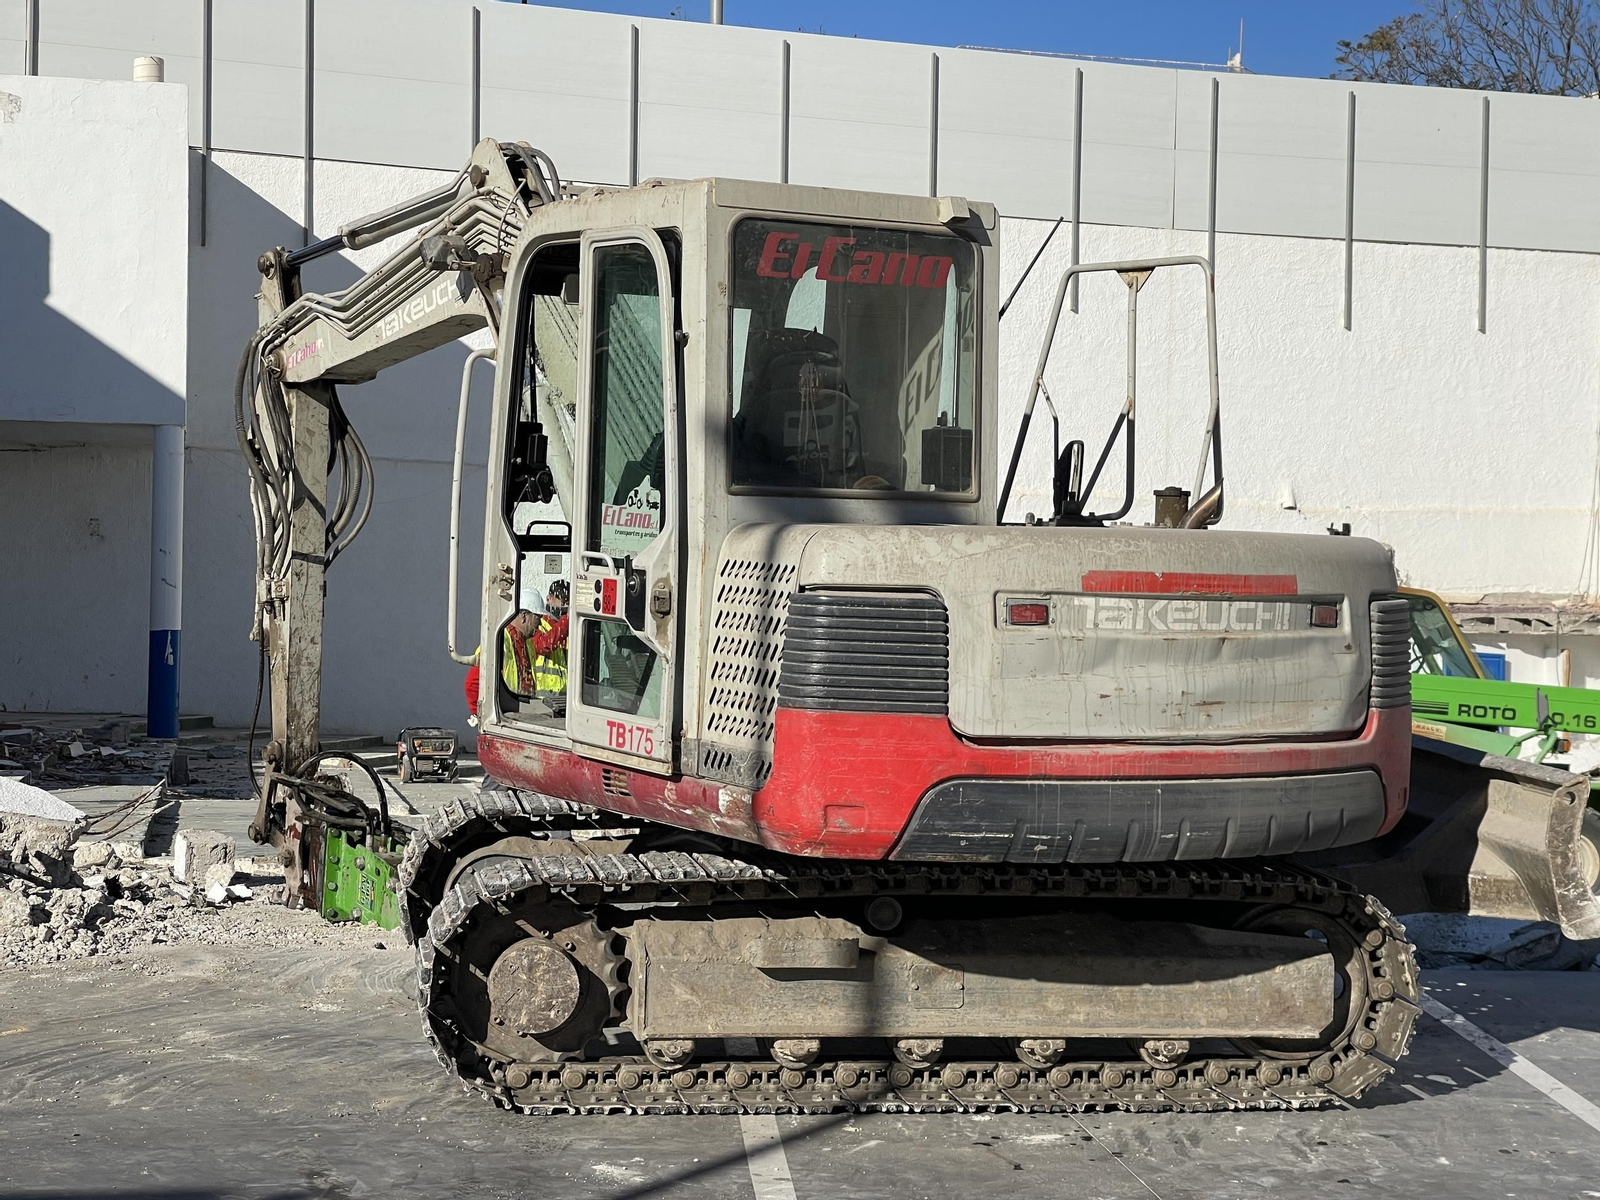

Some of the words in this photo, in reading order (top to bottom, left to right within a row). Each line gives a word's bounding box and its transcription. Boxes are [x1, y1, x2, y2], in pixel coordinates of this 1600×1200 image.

[376, 279, 456, 340] TAKEUCH
[1457, 703, 1517, 721] ROTO
[1551, 711, 1597, 729] 0.16
[606, 719, 654, 755] TB175
